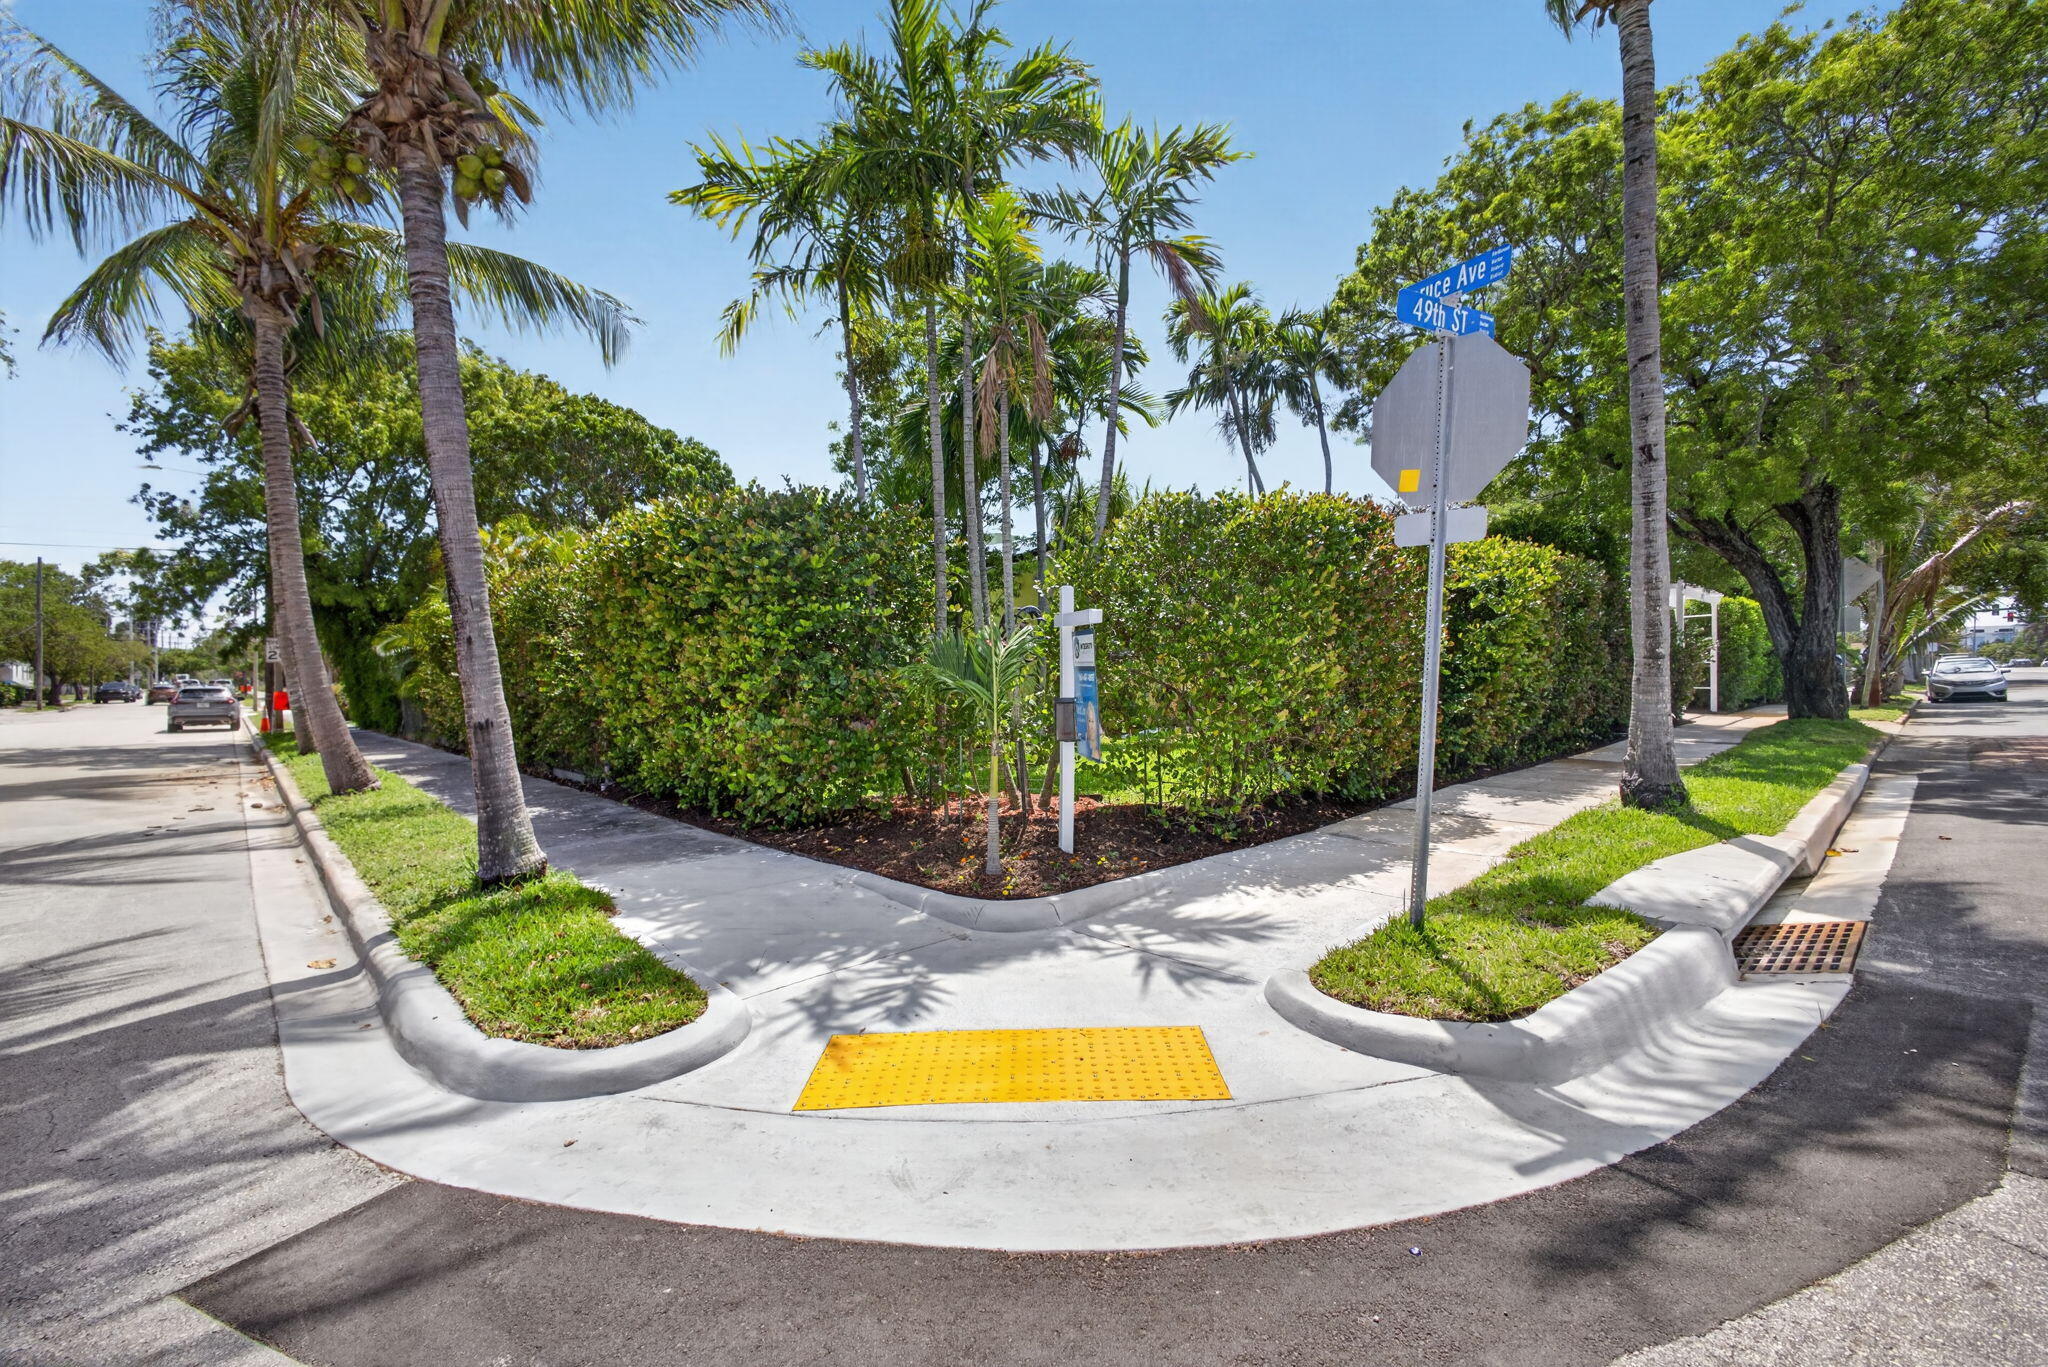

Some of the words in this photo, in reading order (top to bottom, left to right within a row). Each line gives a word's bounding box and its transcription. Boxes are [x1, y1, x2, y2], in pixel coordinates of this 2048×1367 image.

[1456, 261, 1487, 289] Ave
[1412, 297, 1446, 328] 49th
[1451, 308, 1469, 333] ST
[268, 650, 278, 660] 2
